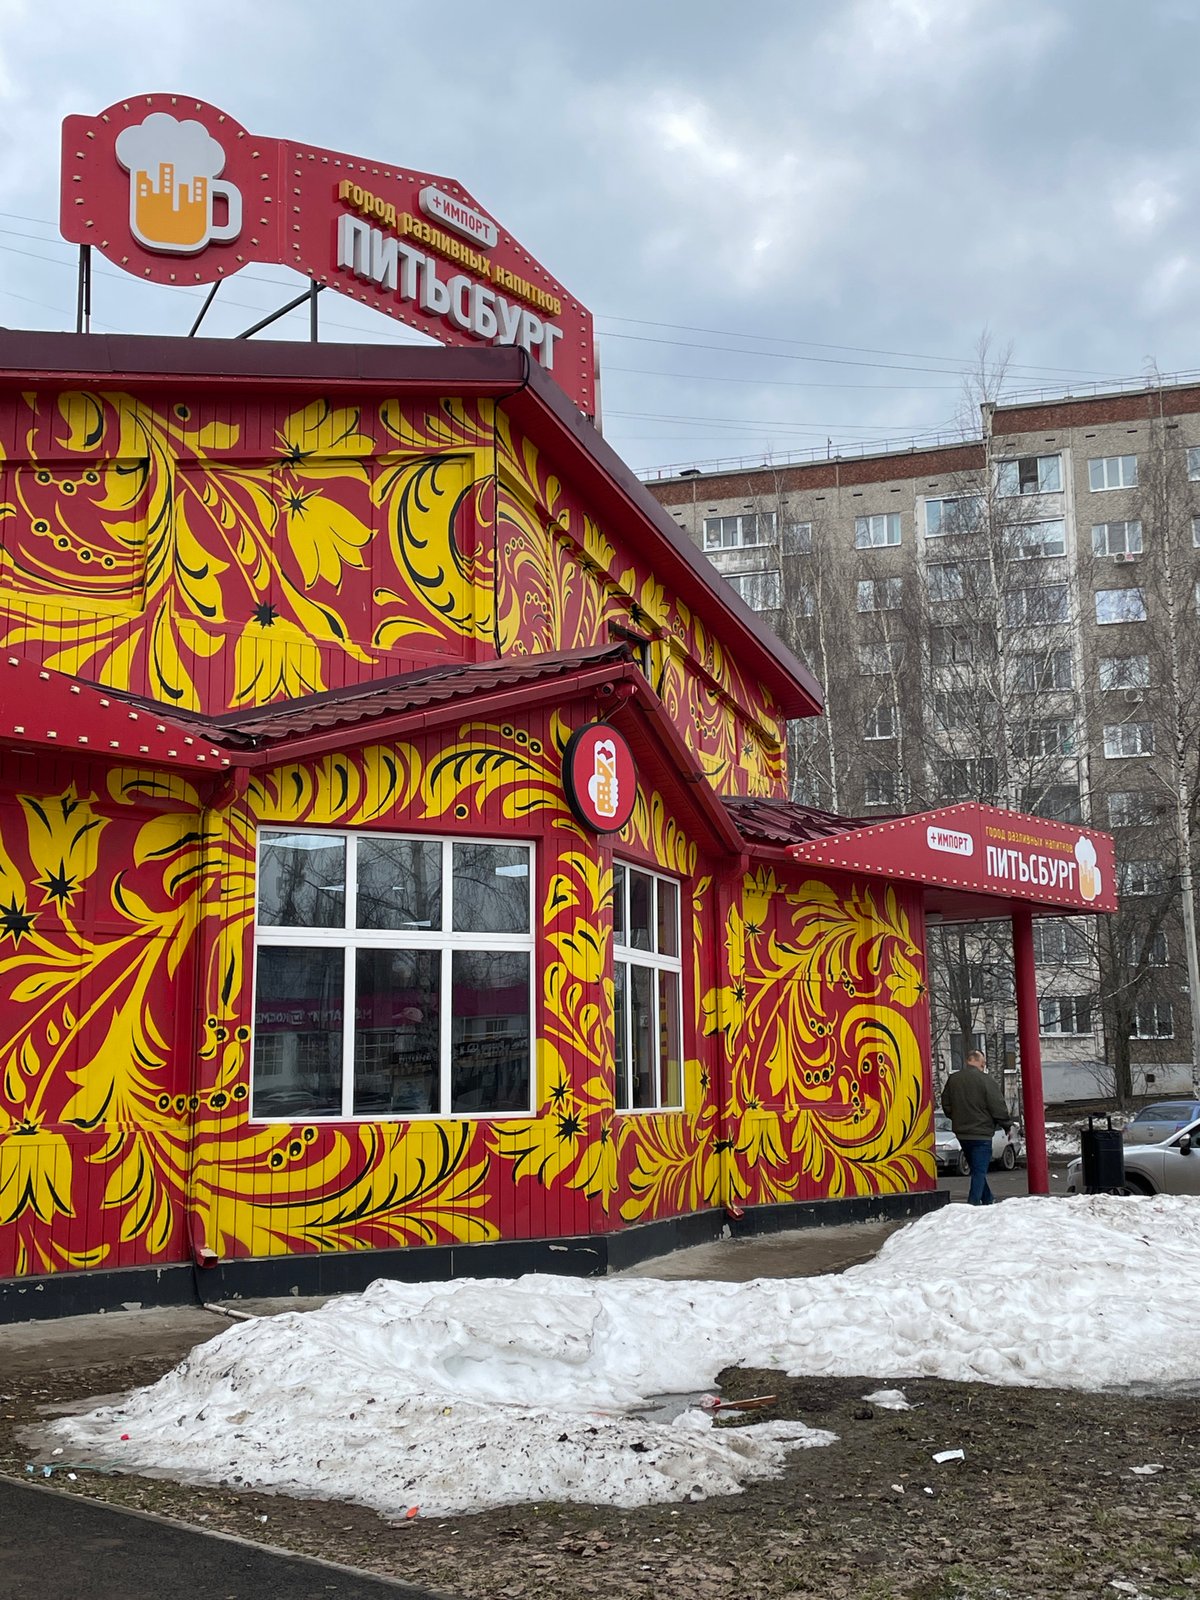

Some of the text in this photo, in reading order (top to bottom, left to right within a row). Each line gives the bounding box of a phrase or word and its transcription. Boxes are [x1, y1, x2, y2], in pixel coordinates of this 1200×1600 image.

[338, 213, 563, 370] ПИТЬСБУРГ
[339, 179, 562, 316] город разливных напитков
[985, 826, 1074, 854] город разливных напитков
[986, 845, 1077, 890] ПИТЬСБУРГ
